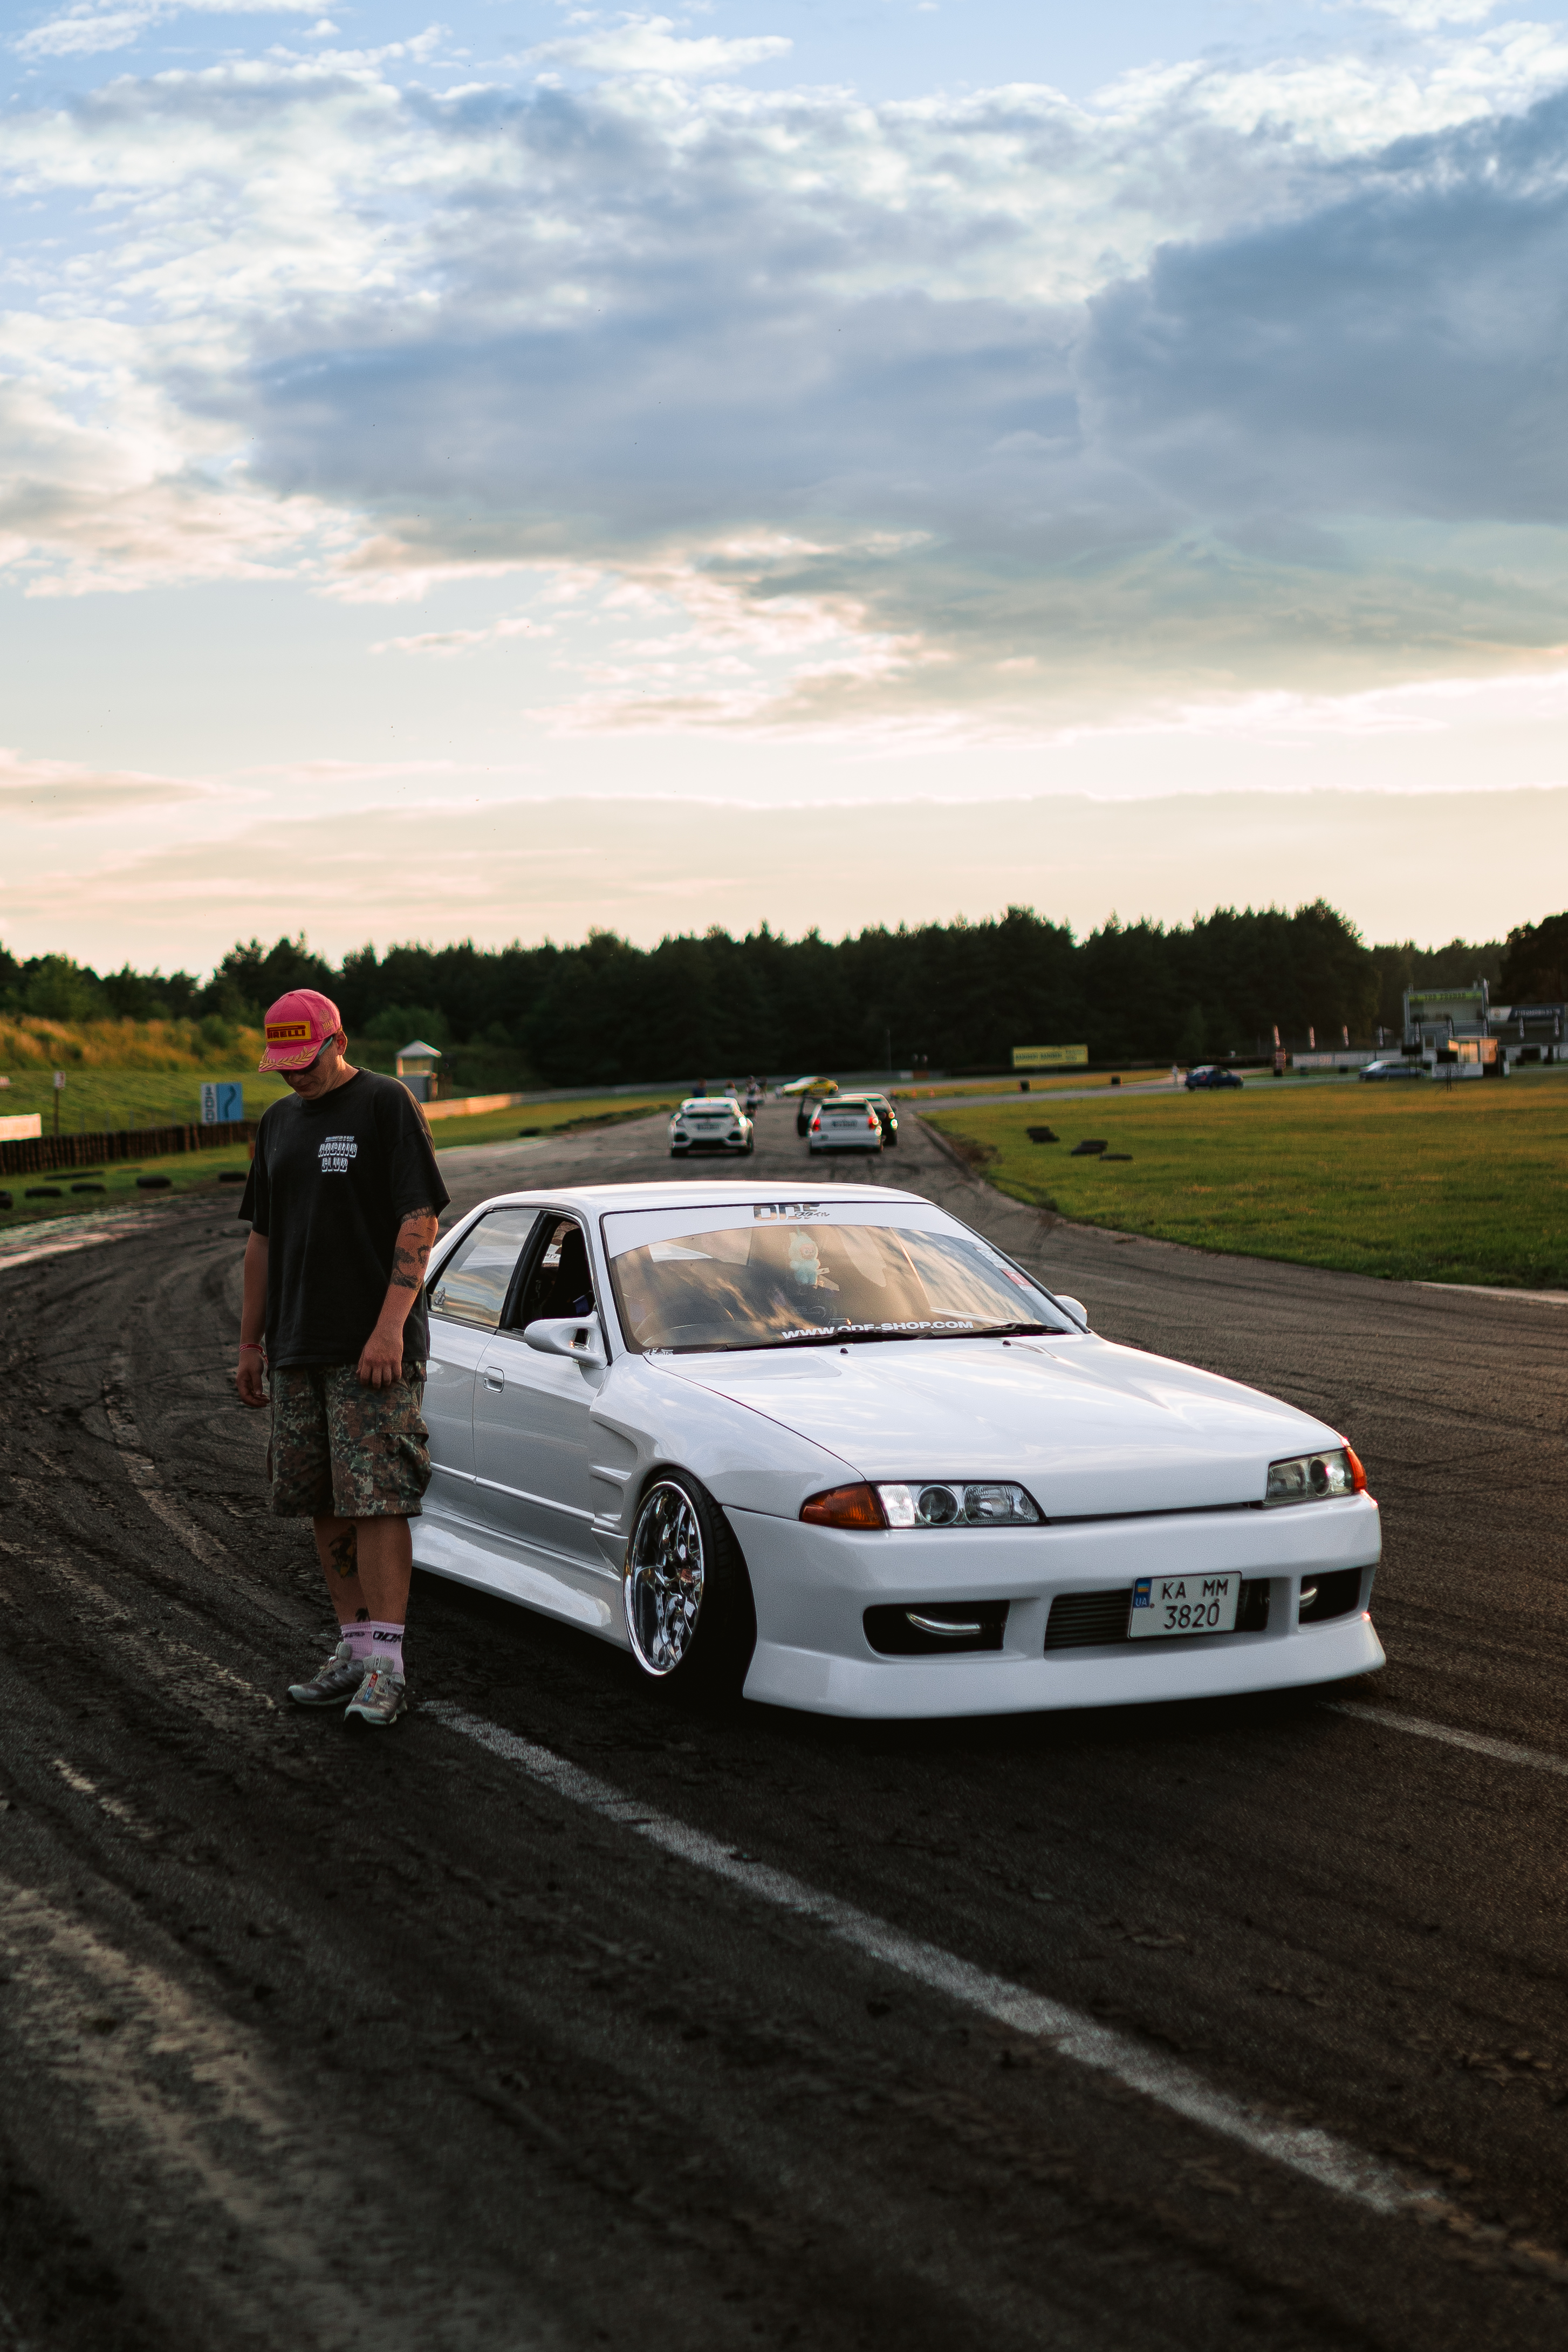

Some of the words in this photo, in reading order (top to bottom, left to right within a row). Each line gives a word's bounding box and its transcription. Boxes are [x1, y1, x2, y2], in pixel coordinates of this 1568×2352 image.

[266, 1024, 306, 1039] PIRELLI
[318, 1143, 358, 1158] RACING
[321, 1157, 348, 1172] CLUB
[782, 1321, 974, 1339] WWWODF-SHOP.COM
[1161, 1581, 1187, 1600] KA
[1202, 1578, 1229, 1597] MM
[1135, 1597, 1148, 1607] UA
[1163, 1602, 1220, 1630] 3820
